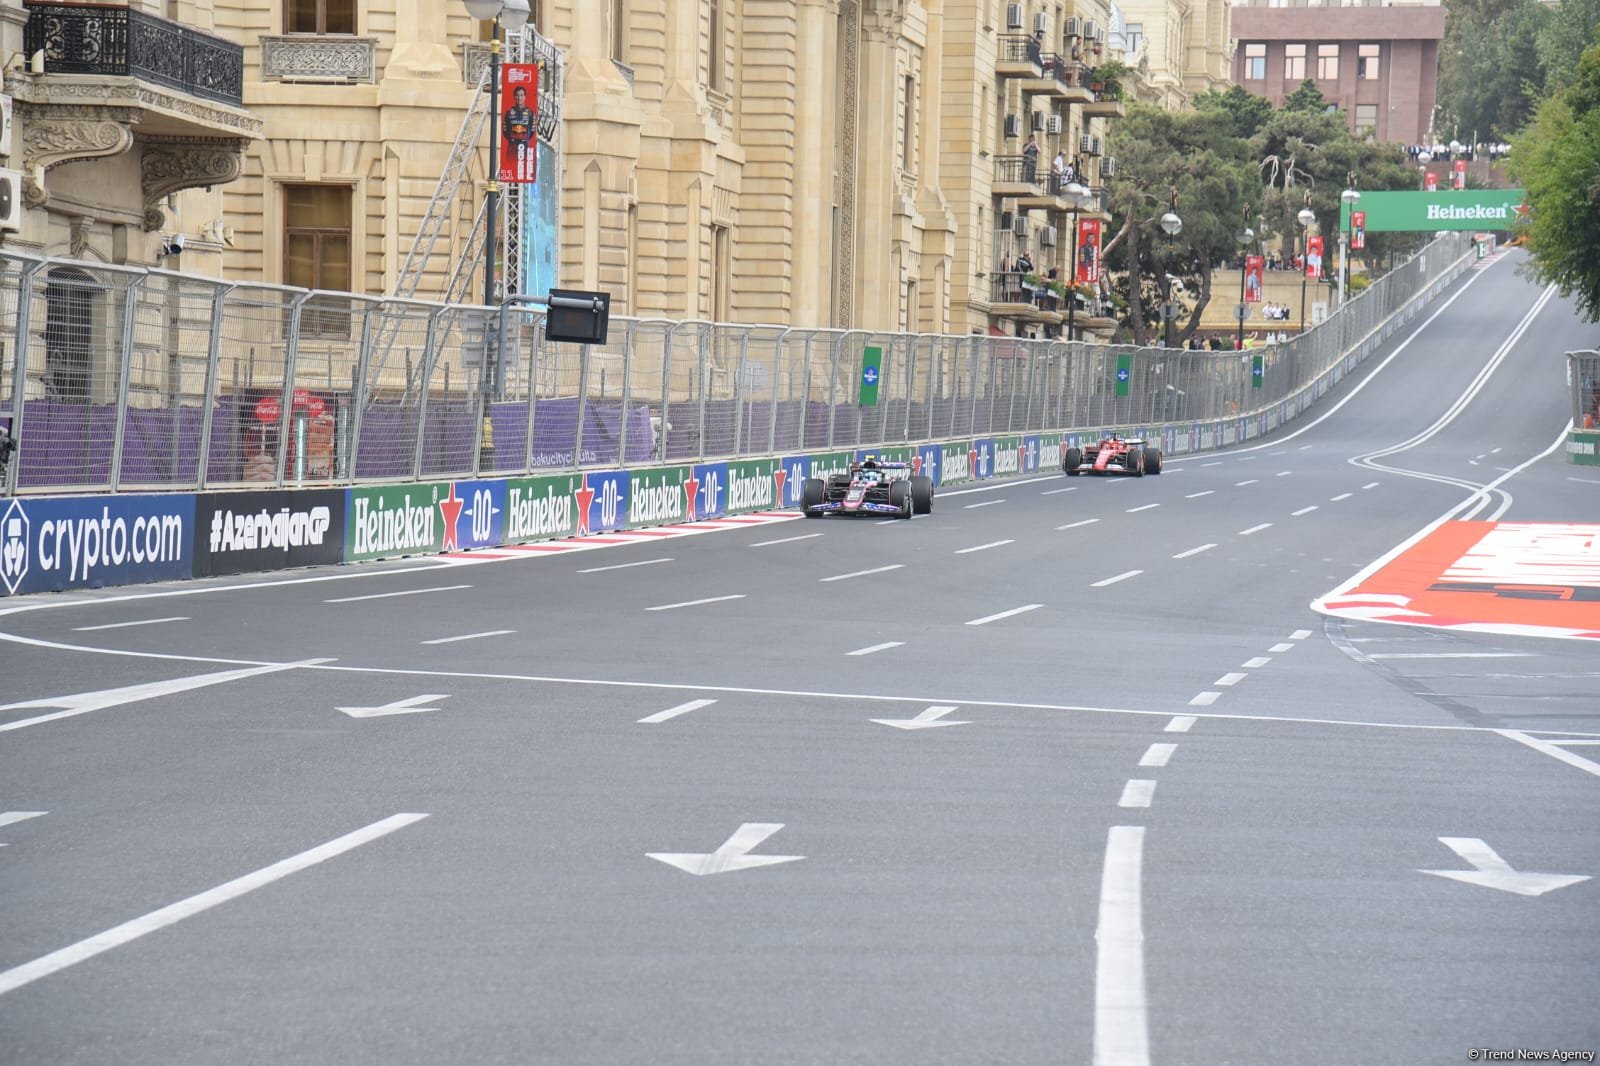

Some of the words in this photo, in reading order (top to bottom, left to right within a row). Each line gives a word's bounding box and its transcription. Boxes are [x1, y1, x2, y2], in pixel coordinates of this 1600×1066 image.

[38, 506, 182, 581] crypto.com
[210, 506, 330, 552] #AzerbaijanGP
[354, 495, 434, 554] Heineken
[472, 489, 491, 541] 0.0
